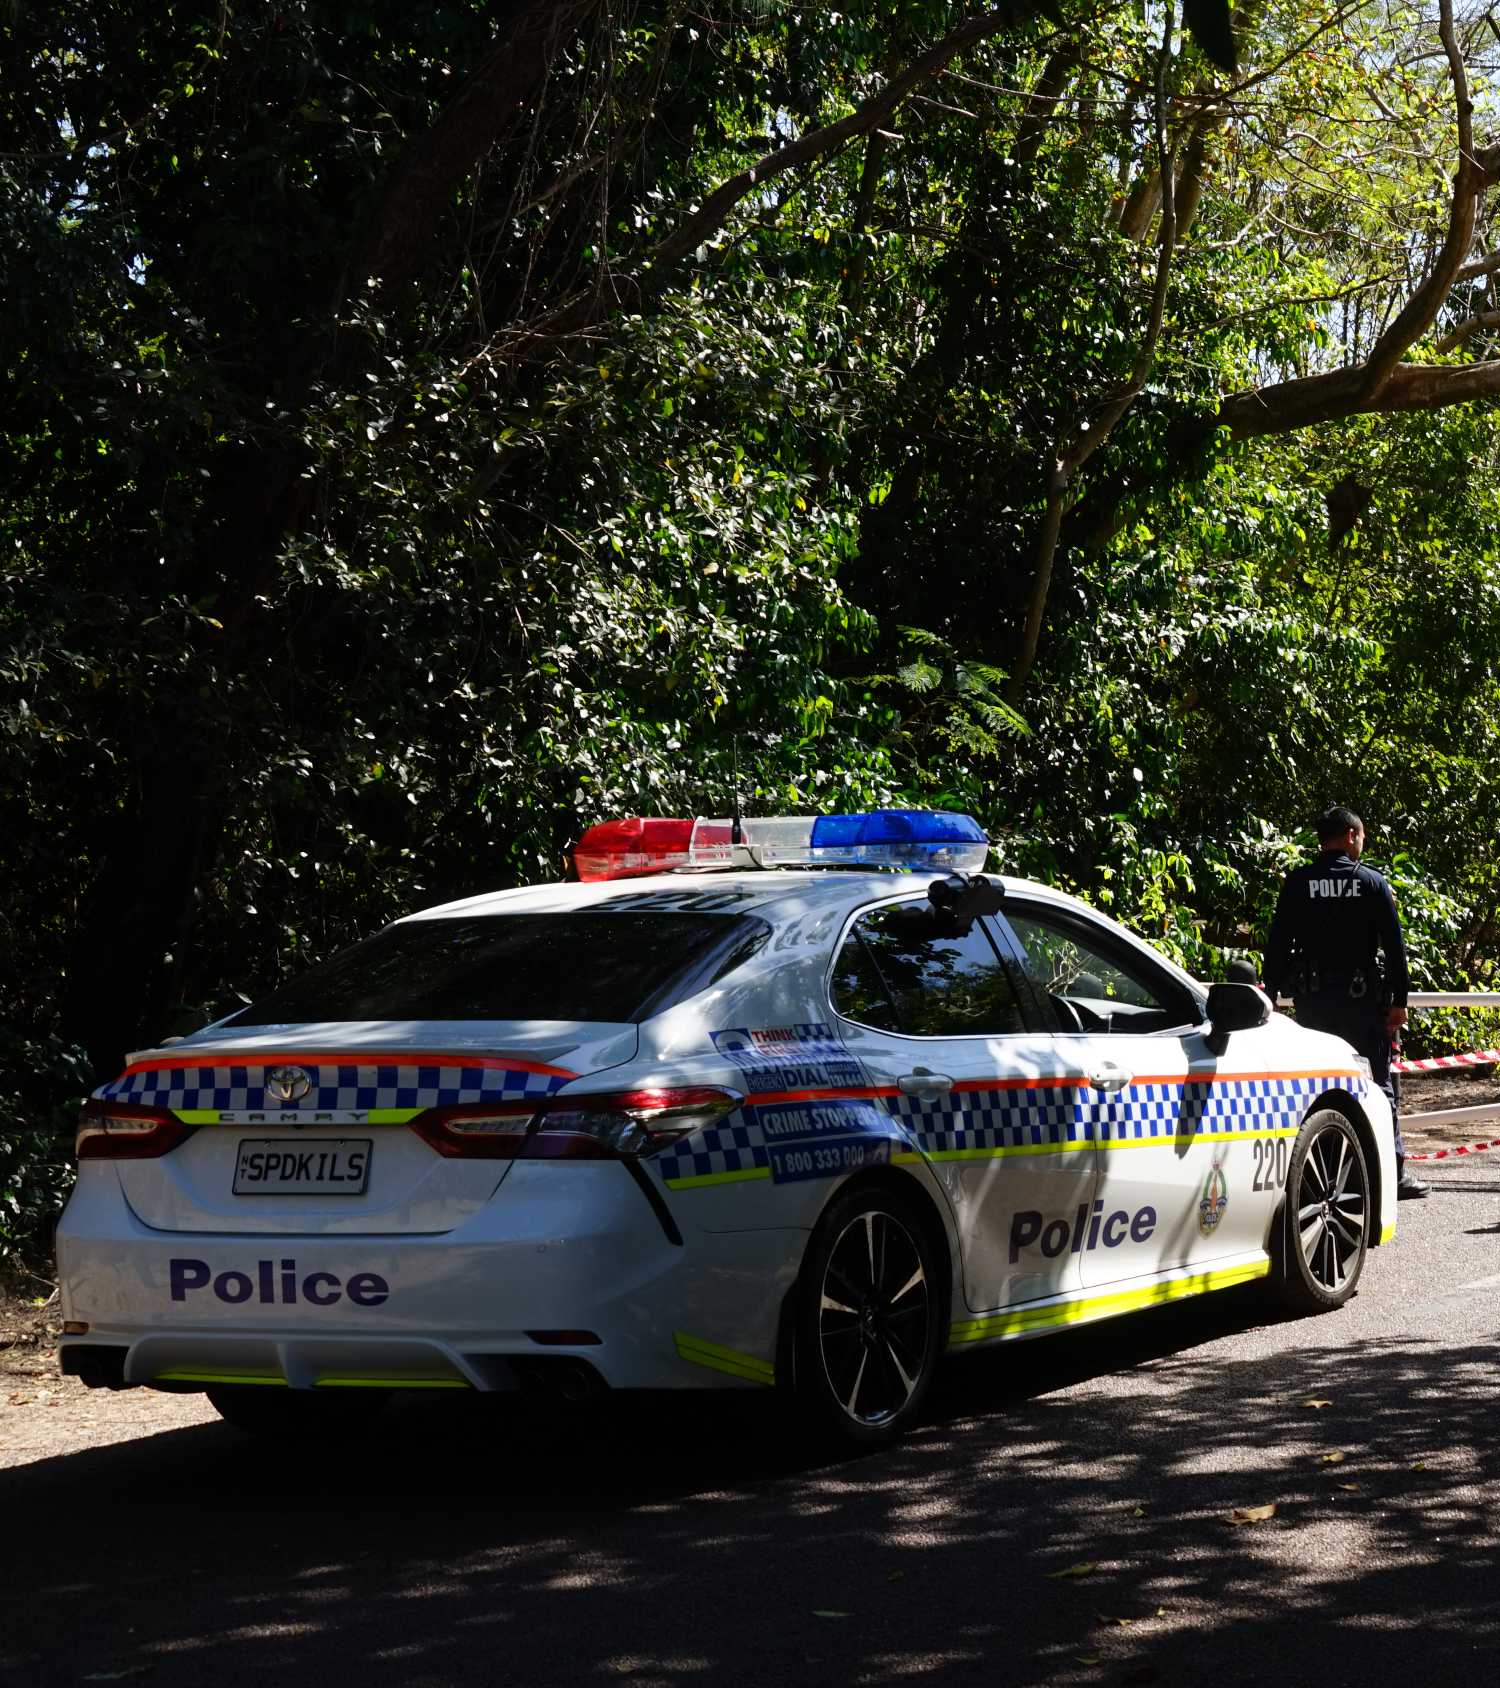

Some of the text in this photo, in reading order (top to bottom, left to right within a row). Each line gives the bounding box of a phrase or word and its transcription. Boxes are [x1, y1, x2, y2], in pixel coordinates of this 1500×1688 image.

[573, 892, 755, 911] 220
[1308, 879, 1361, 898] POLICE
[752, 1028, 798, 1043] THINK
[783, 1068, 829, 1087] DIAL
[219, 1112, 369, 1121] CAMRY
[763, 1105, 881, 1135] CRIME STOPPERS
[248, 1152, 365, 1181] SPDKILS
[773, 1145, 865, 1175] 1 800 333 000
[1252, 1136, 1287, 1193] 220
[1009, 1199, 1157, 1264] Police
[169, 1258, 389, 1306] Police
